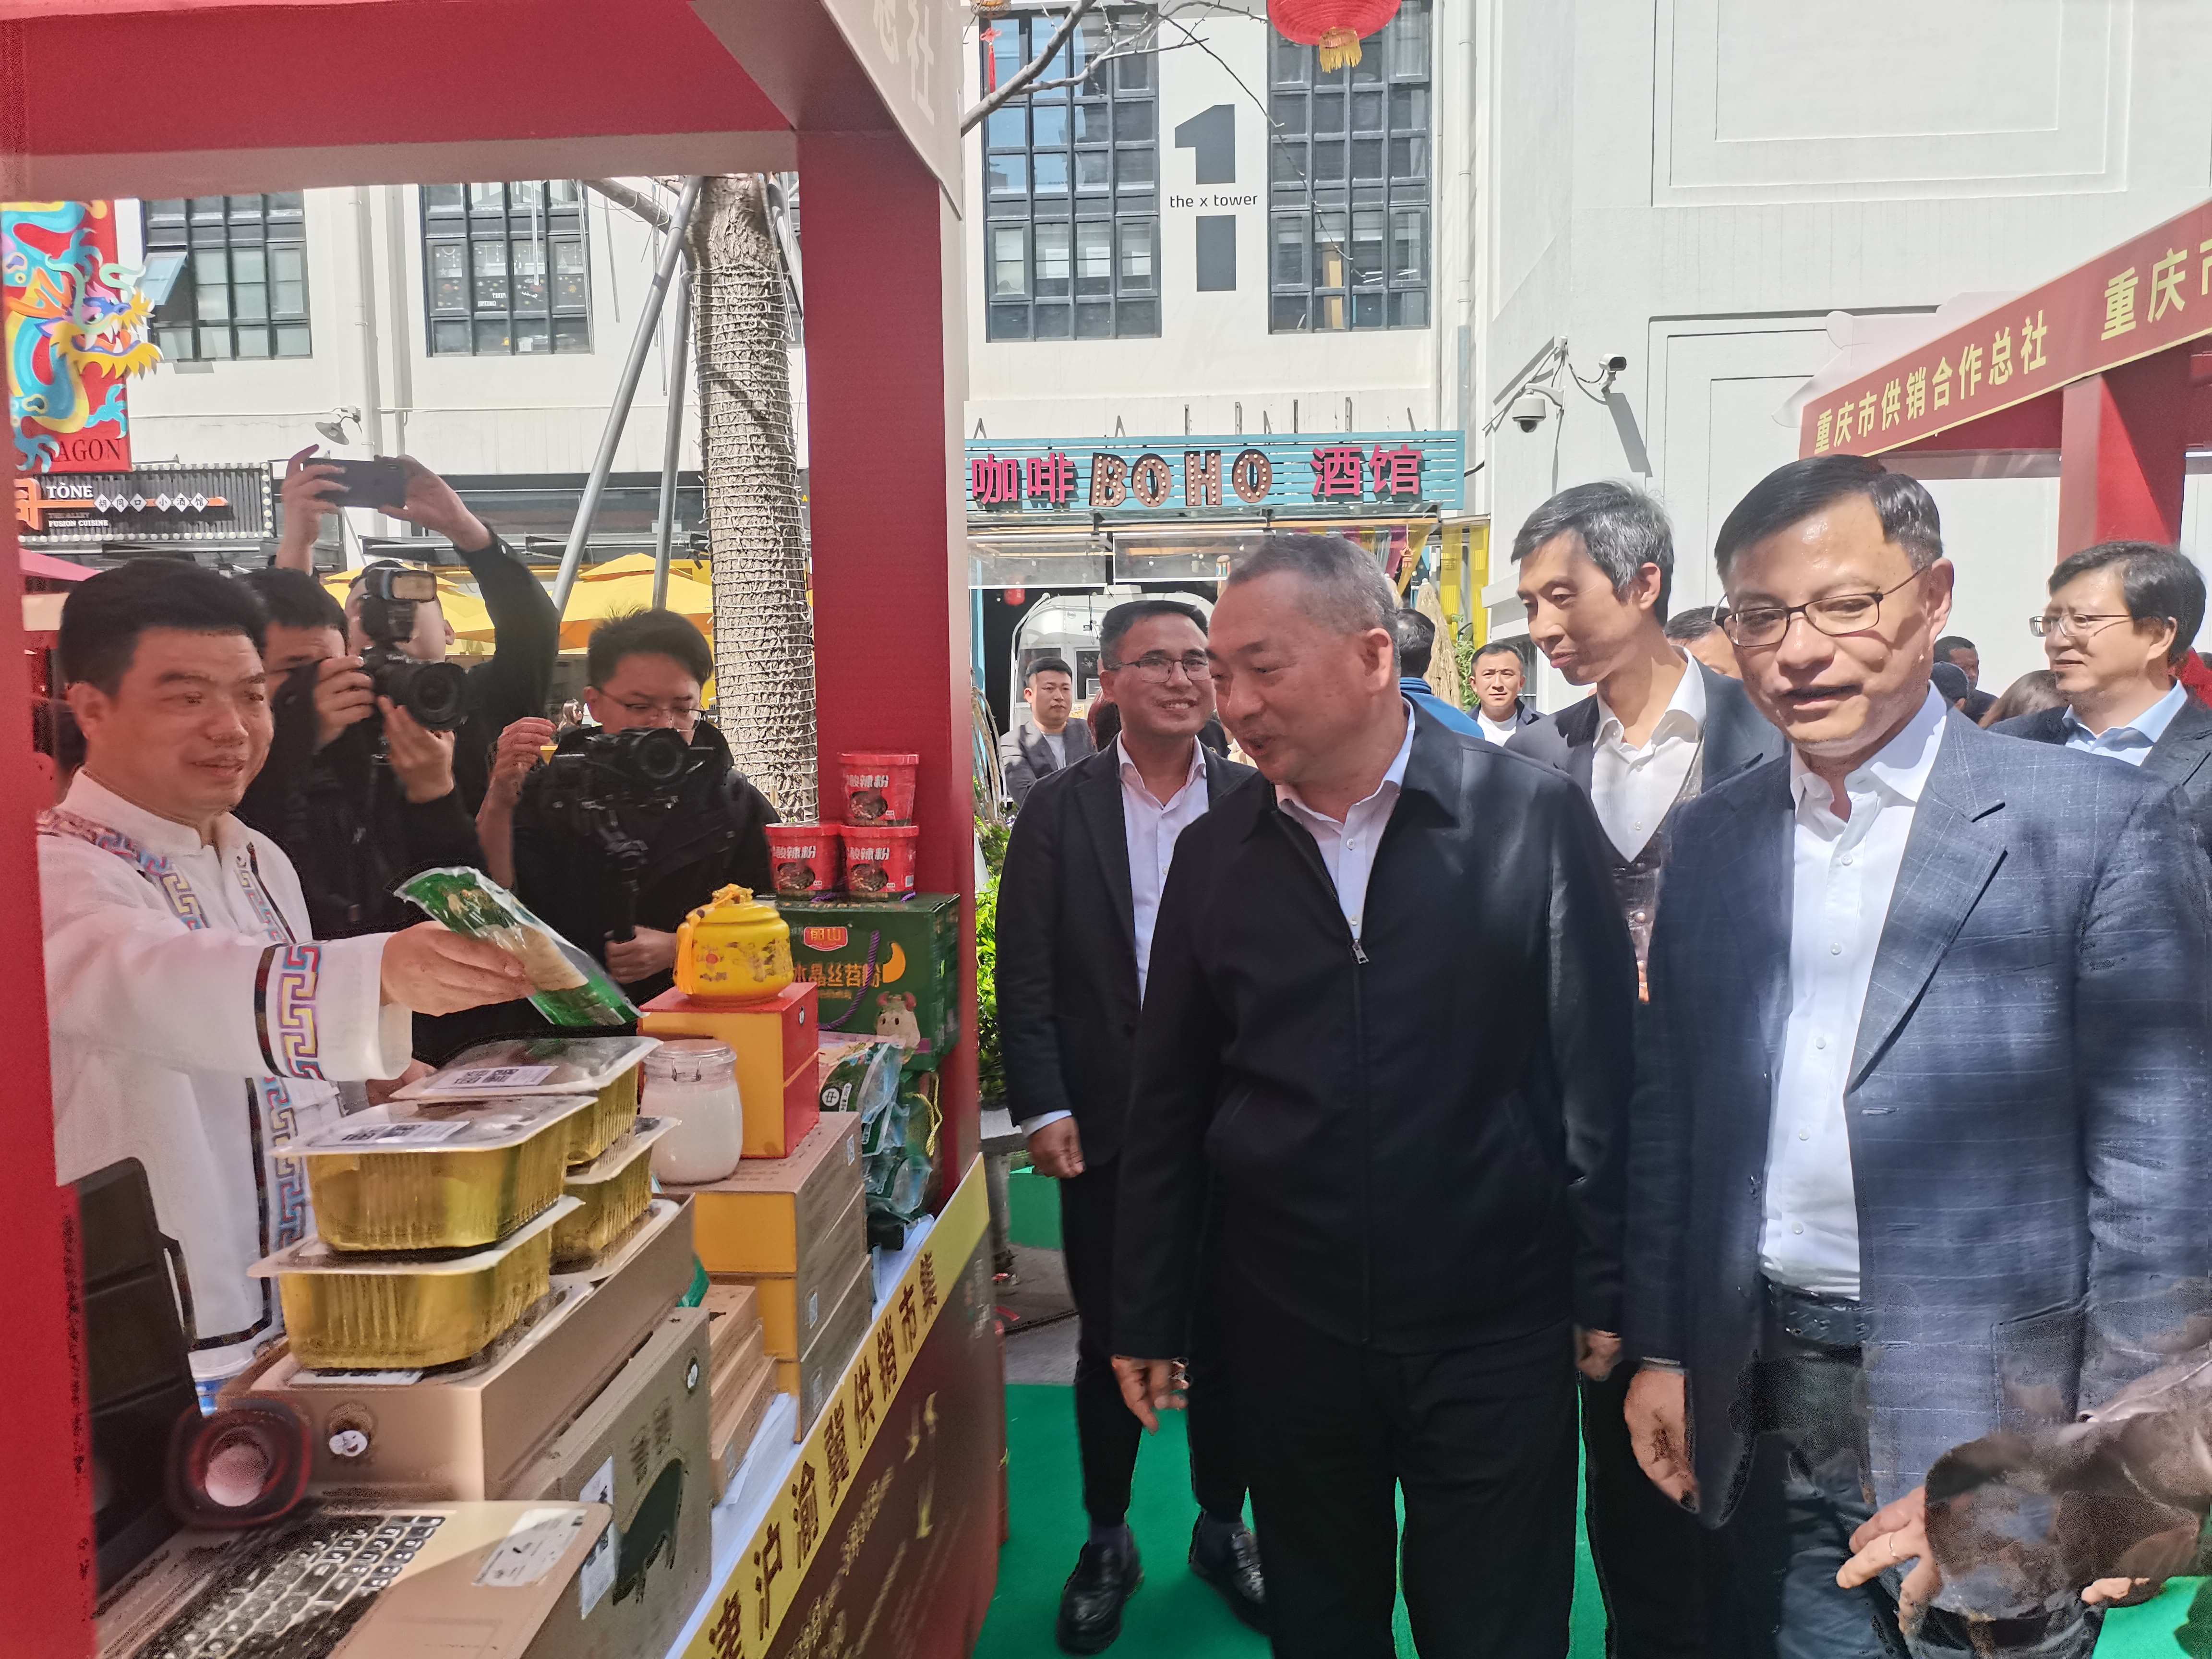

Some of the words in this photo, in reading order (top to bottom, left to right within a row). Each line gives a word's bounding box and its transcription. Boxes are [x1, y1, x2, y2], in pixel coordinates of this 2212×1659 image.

[1170, 195, 1194, 208] the
[1199, 197, 1208, 207] x
[1214, 194, 1258, 206] tower
[1814, 309, 2047, 455] 重庆市供销合作总社
[972, 452, 1074, 505] 咖啡
[1089, 448, 1273, 508] BOHO
[1310, 443, 1424, 497] 酒馆
[78, 519, 109, 527] CUISINE
